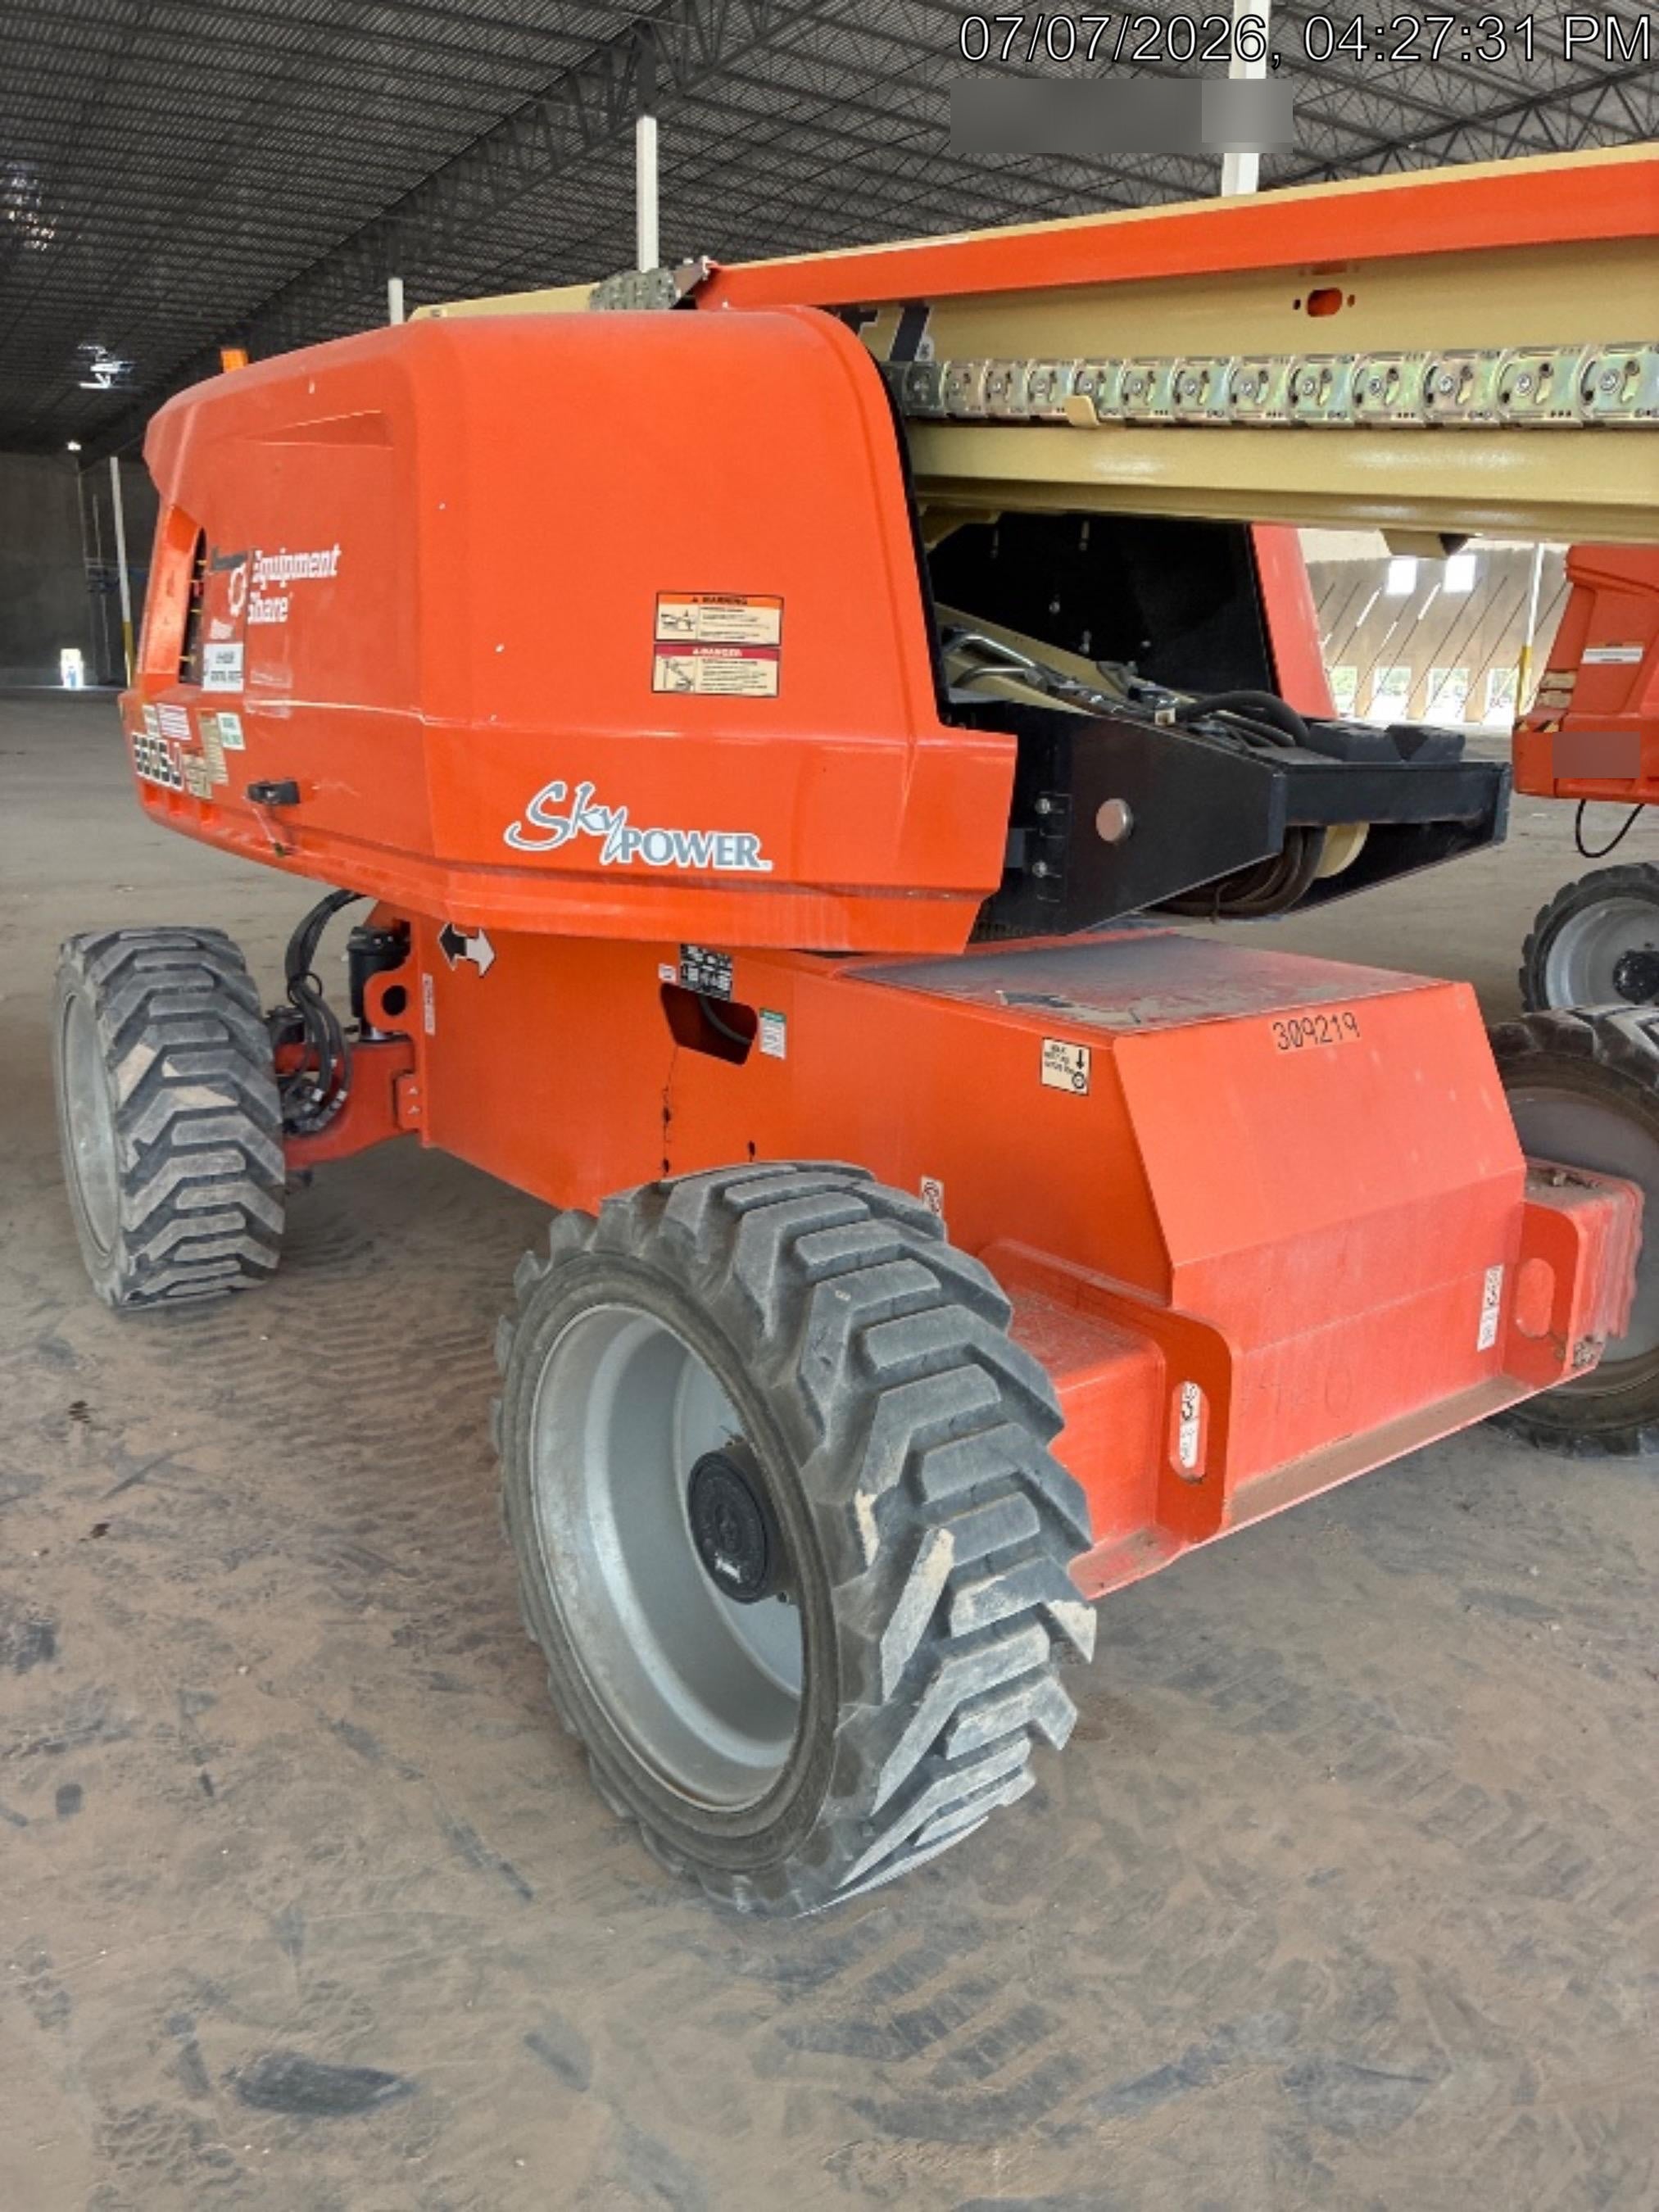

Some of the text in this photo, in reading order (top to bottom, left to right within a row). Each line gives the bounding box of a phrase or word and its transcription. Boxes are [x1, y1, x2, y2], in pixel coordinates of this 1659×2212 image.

[252, 543, 341, 590] Equipment
[247, 592, 288, 625] Share
[1272, 1012, 1360, 1050] 309219
